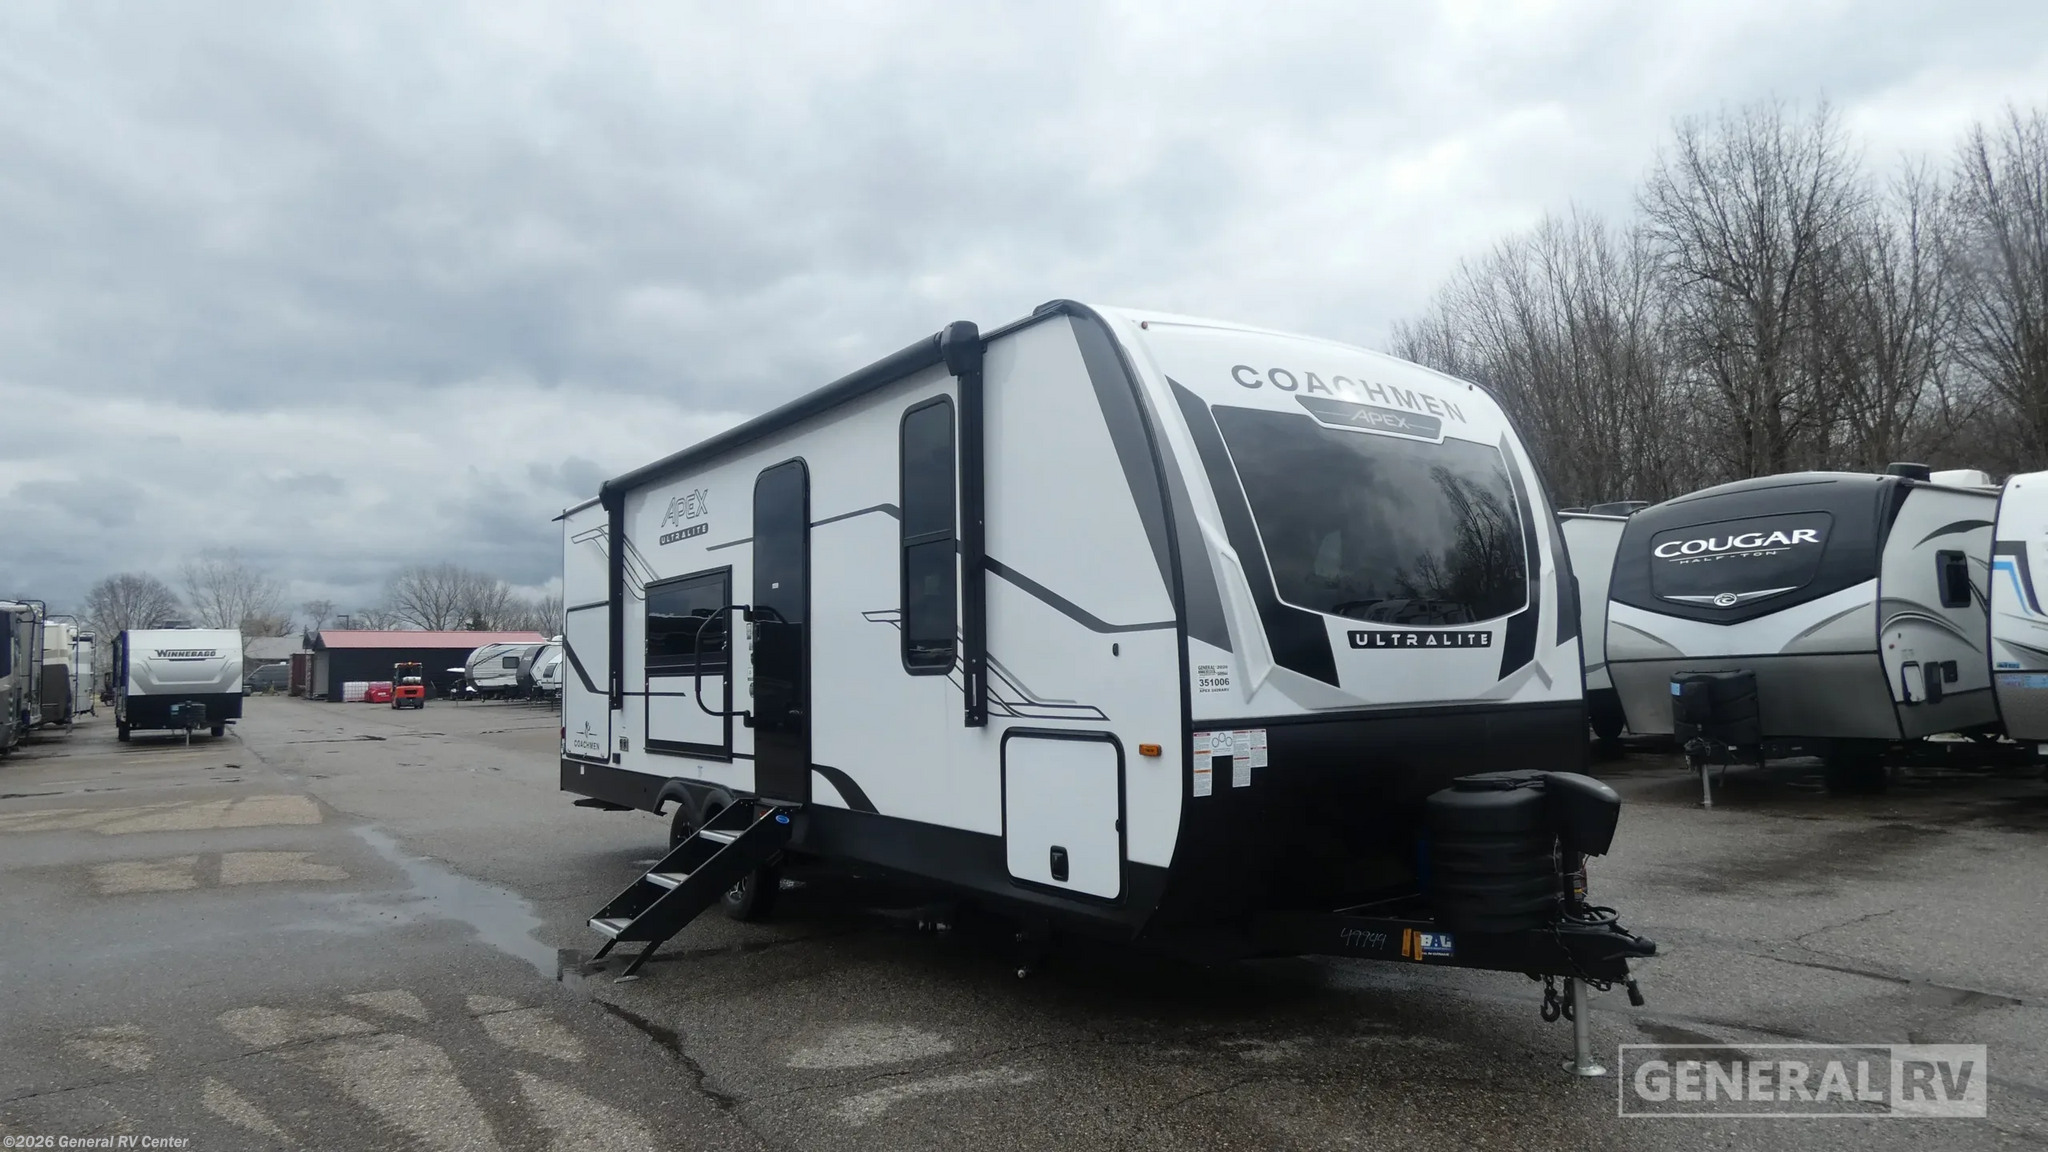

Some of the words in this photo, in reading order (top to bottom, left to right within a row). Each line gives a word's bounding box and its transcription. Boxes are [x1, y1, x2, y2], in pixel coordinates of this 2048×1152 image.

[1231, 364, 1467, 424] COACHMEN
[1351, 409, 1411, 430] APEX
[661, 489, 708, 528] APEX
[661, 524, 707, 544] ULTRALITE
[1654, 528, 1820, 558] COUGAR
[1356, 633, 1488, 646] ULTRALITE
[154, 649, 217, 658] WINNEBAGO
[1199, 678, 1230, 687] 351006
[573, 740, 600, 750] COACHMEN
